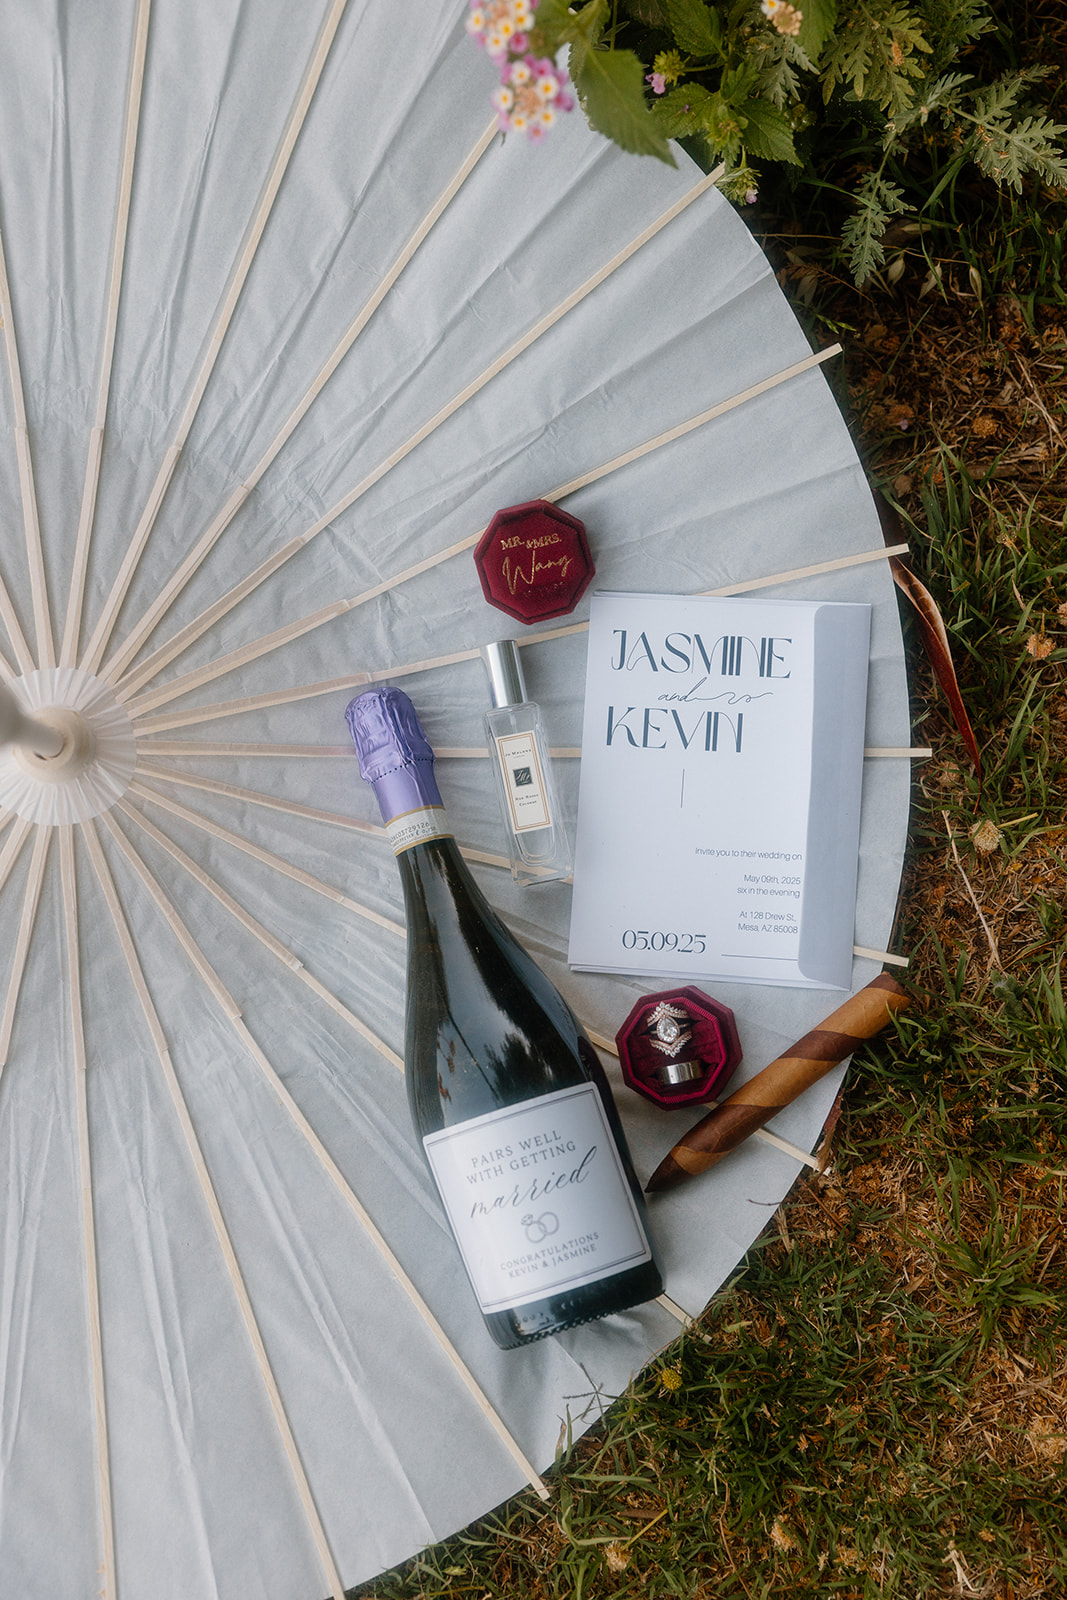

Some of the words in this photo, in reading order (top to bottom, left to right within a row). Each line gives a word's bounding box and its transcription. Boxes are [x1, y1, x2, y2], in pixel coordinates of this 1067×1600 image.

[502, 550, 573, 595] Wang
[611, 629, 792, 679] JASMINE
[606, 705, 743, 753] KEVIN
[716, 849, 731, 858] you
[732, 849, 739, 857] to
[740, 849, 756, 858] their
[757, 851, 790, 862] wedding
[743, 874, 760, 884] May
[781, 876, 801, 885] 2025
[756, 887, 768, 896] the
[769, 889, 801, 899] evening
[750, 911, 764, 919] 128
[764, 912, 785, 920] Drew
[761, 924, 772, 932] AZ
[773, 925, 799, 934] 85008
[622, 929, 707, 954] 05.09.25
[466, 1165, 504, 1184] WITH
[509, 1140, 576, 1171] GETTING
[471, 1146, 514, 1168] PAIRS
[518, 1130, 561, 1151] WELL
[470, 1145, 598, 1219] married
[500, 1231, 600, 1271] CONGRATULATIONS
[508, 1263, 539, 1279] KEVIN
[542, 1260, 549, 1268] &
[552, 1243, 597, 1268] JASMINE
